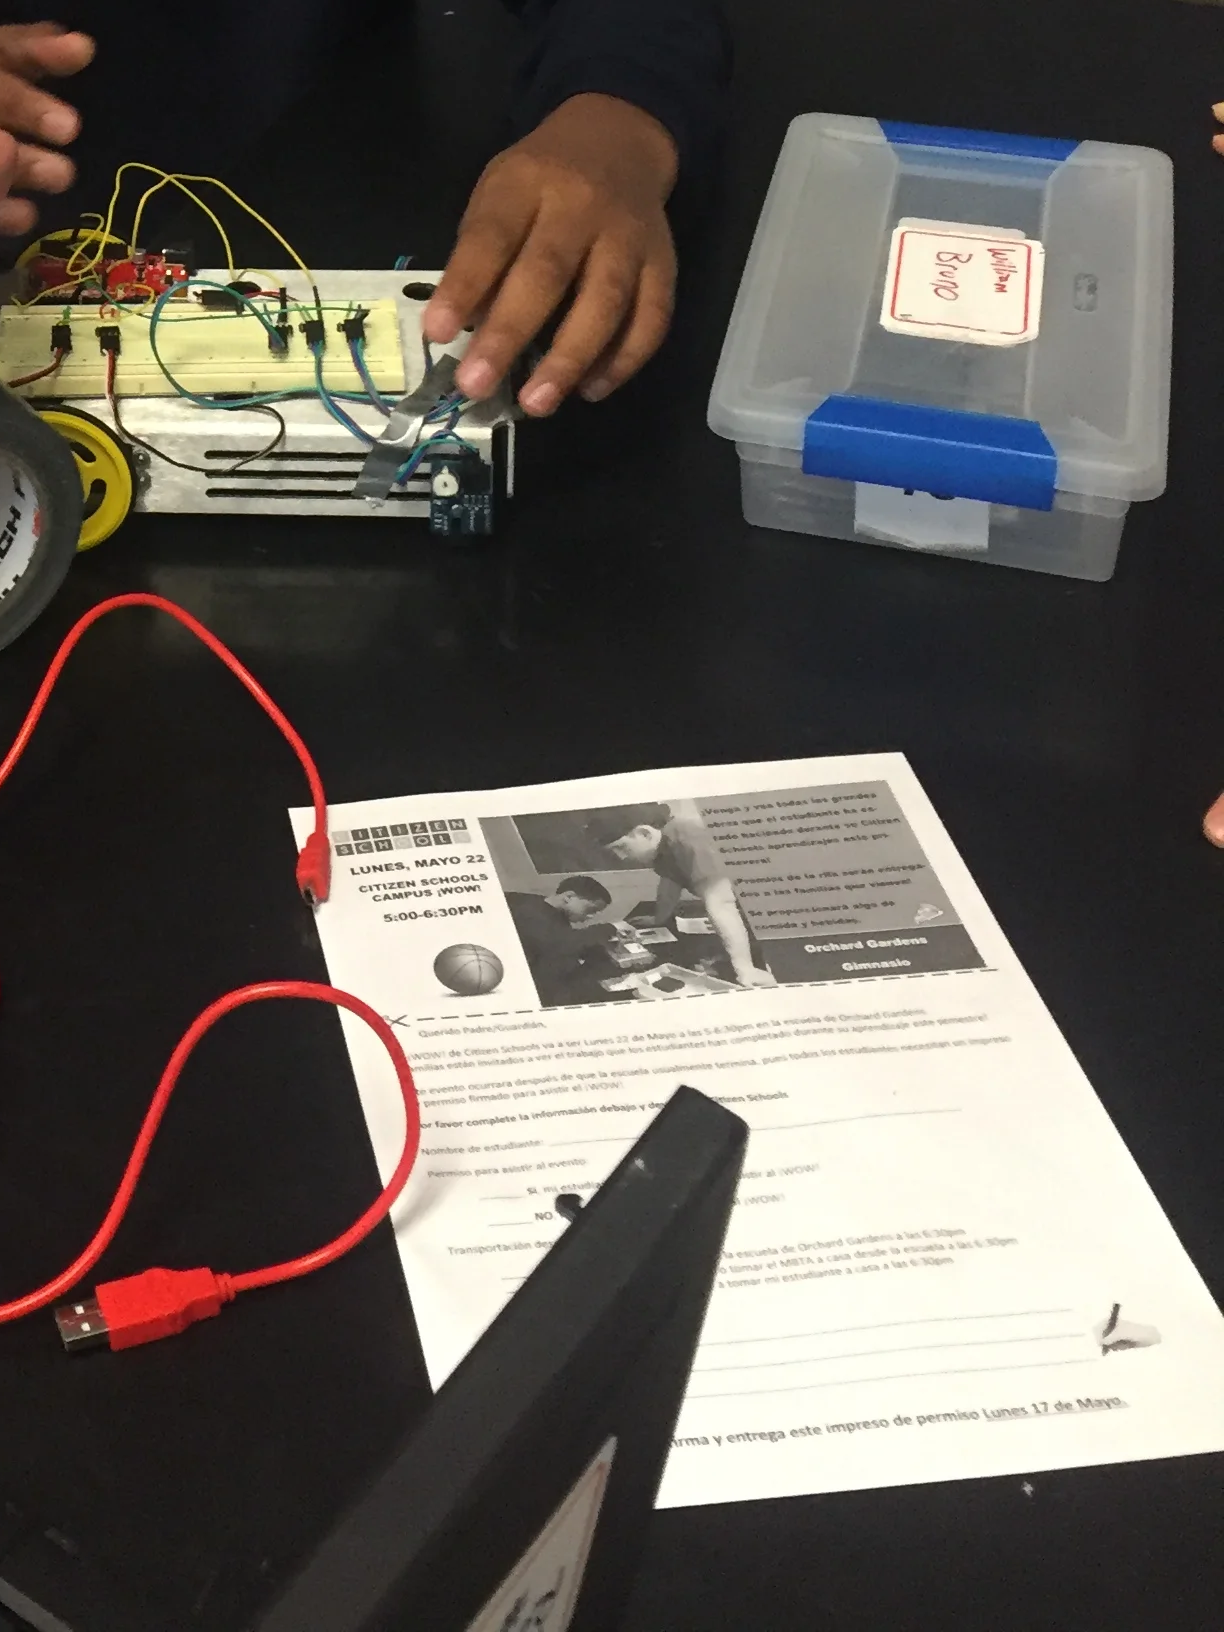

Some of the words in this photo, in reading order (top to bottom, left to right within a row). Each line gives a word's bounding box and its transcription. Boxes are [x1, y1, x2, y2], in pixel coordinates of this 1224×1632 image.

[350, 861, 411, 876] LUNES,
[414, 856, 461, 869] MAYO
[465, 854, 487, 864] 22
[358, 879, 417, 894] CITIZEN
[421, 873, 489, 887] SCHOOLS
[372, 889, 433, 902] CAMPUS
[383, 905, 484, 923] 5:00-6:30PM
[804, 939, 864, 954] Orchard
[866, 935, 929, 950] Gardens
[841, 958, 912, 972] Gimnasio
[418, 1028, 461, 1039] Querido
[448, 1049, 462, 1058] de
[463, 1047, 499, 1057] Citizen
[500, 1042, 541, 1054] Schools
[584, 1037, 615, 1046] Lunes
[423, 1097, 467, 1108] permiso
[435, 1120, 464, 1129] favor
[466, 1114, 517, 1127] complete
[519, 1113, 530, 1121] la
[599, 1103, 637, 1113] debajo
[747, 1090, 789, 1102] Schools
[421, 1146, 465, 1156] Nombre
[468, 1145, 481, 1154] de
[427, 1169, 473, 1179] Permiso
[475, 1168, 499, 1177] para
[502, 1164, 532, 1174] asistir
[736, 1247, 779, 1258] escuela
[797, 1238, 844, 1251] Orchard
[712, 1433, 724, 1448] y
[727, 1428, 787, 1445] entrega
[789, 1423, 822, 1439] este
[825, 1416, 890, 1436] impreso
[892, 1411, 913, 1428] de
[916, 1407, 981, 1428] permiso
[981, 1404, 1029, 1421] Lunes
[1032, 1400, 1050, 1415] 17
[1054, 1398, 1074, 1413] de
